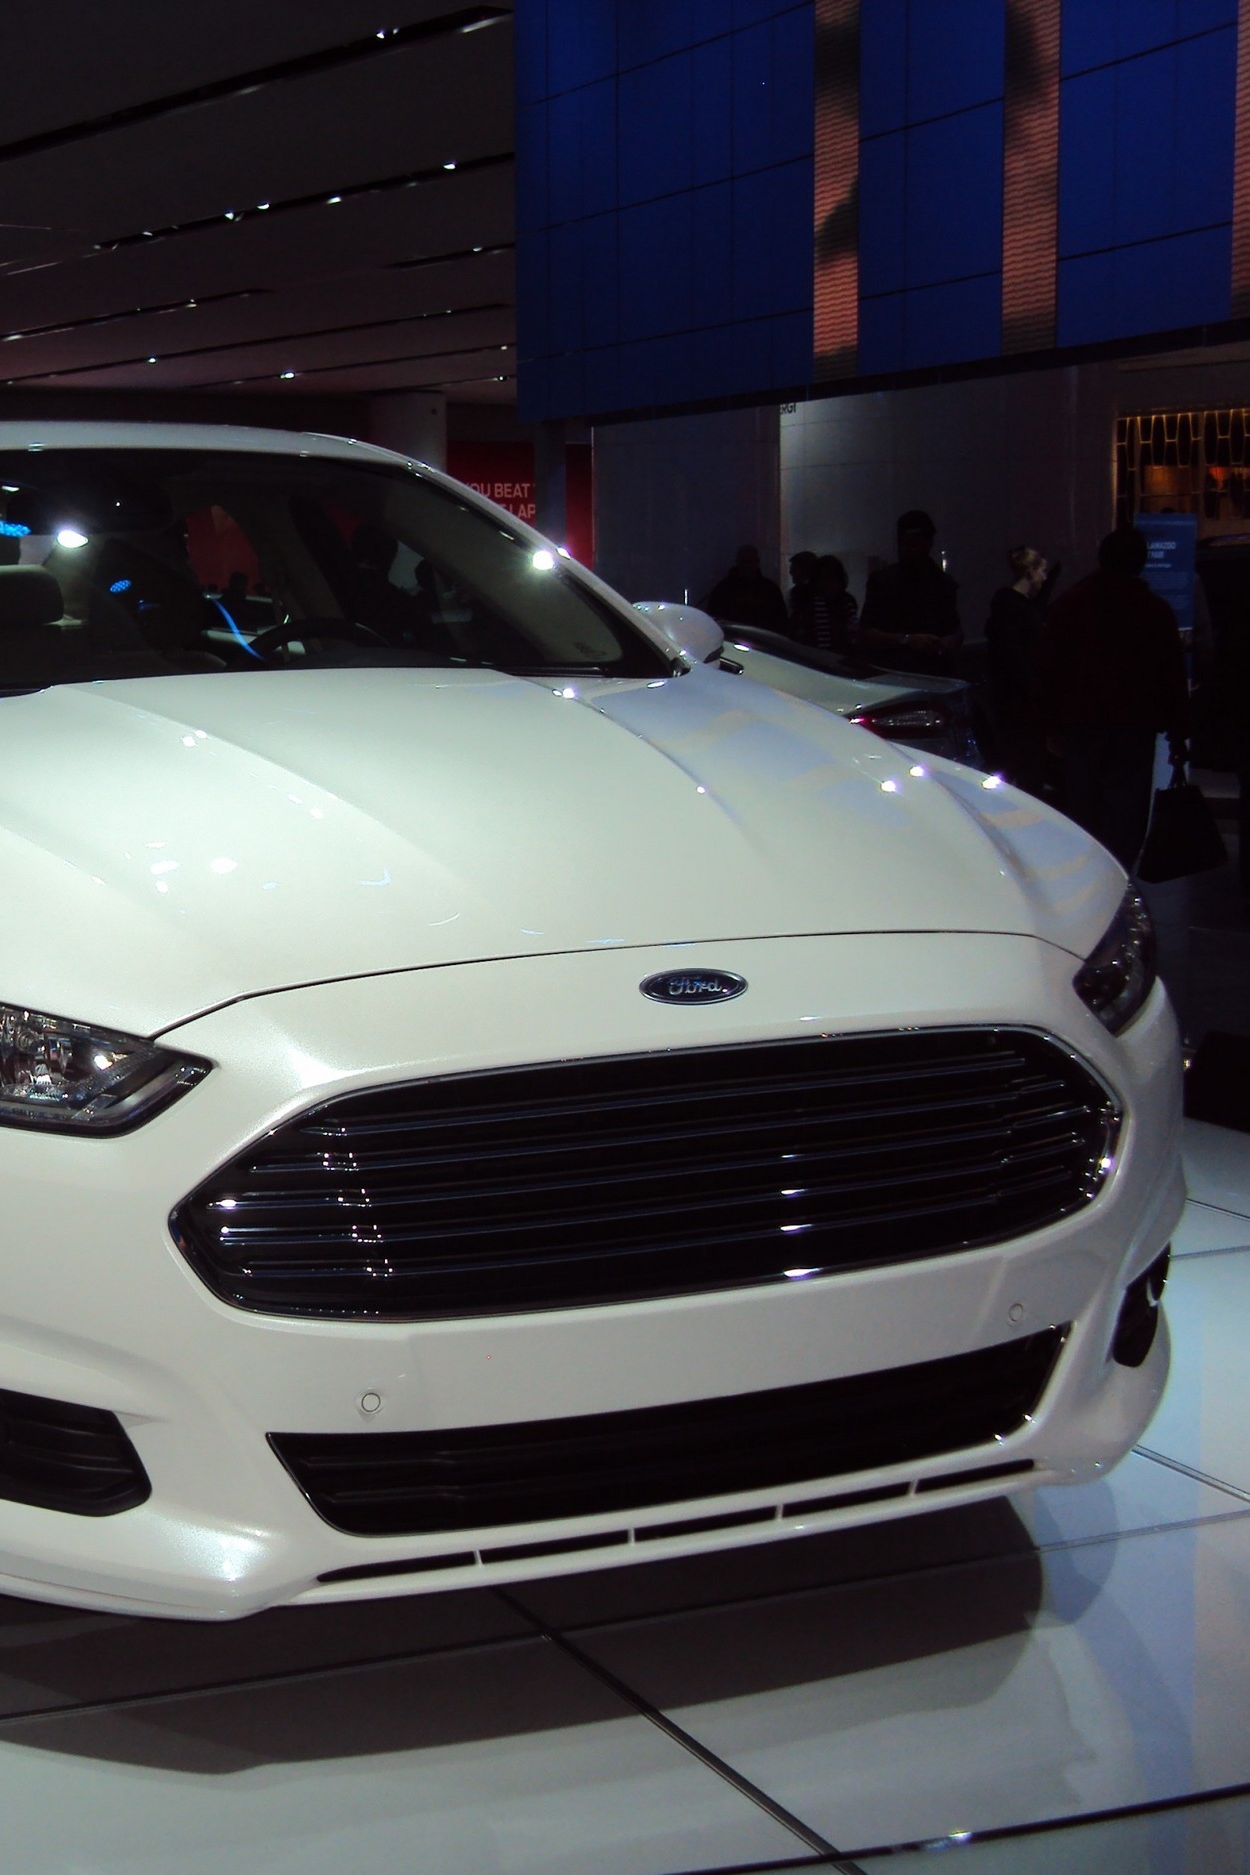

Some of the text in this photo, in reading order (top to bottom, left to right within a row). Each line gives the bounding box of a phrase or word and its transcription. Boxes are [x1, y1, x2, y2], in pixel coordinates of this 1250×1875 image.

[780, 402, 797, 414] RGI
[467, 482, 531, 498] OU BEAT
[668, 977, 722, 996] Ford
